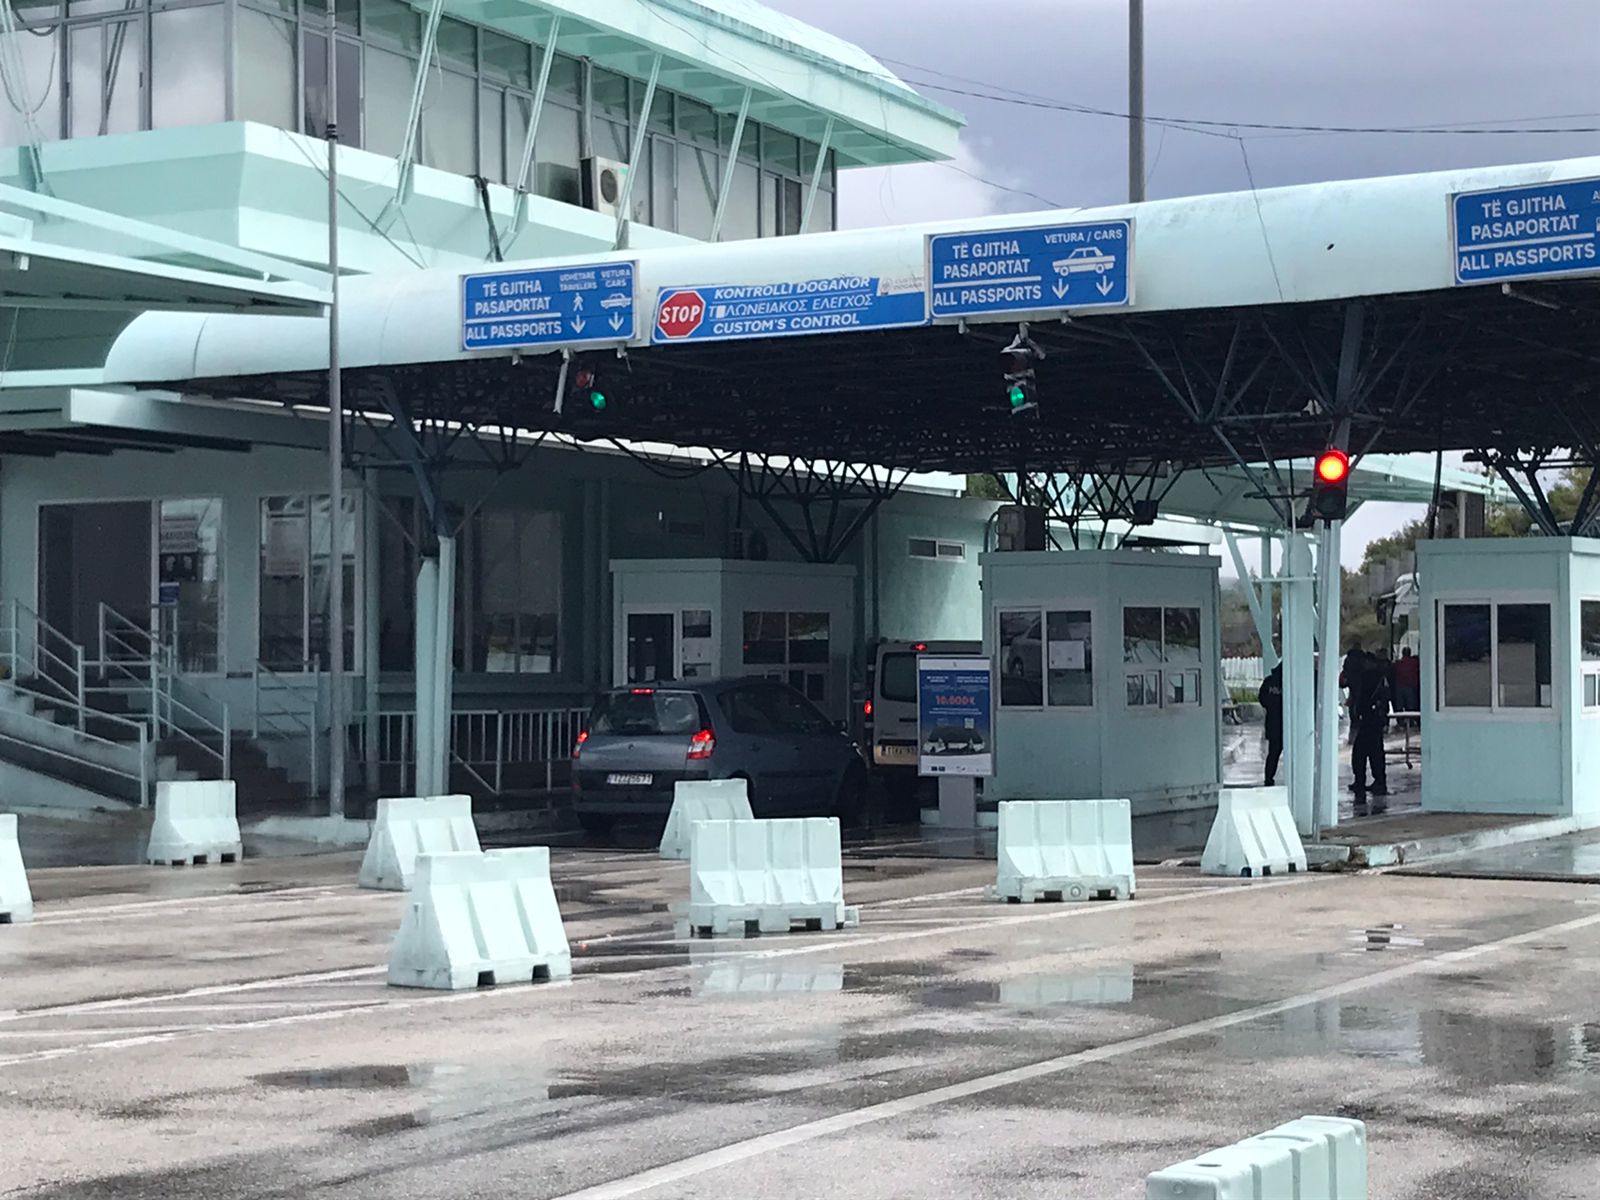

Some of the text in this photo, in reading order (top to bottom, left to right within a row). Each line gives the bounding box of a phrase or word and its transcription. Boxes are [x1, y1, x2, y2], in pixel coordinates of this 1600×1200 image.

[1481, 194, 1566, 218] TË GJITHA
[1044, 231, 1084, 245] VETURA
[1094, 229, 1123, 241] CARS
[1471, 214, 1580, 241] PASAPORTAT
[972, 240, 1020, 258] GJITHA
[1460, 243, 1596, 272] ALL PASSPORTS
[601, 269, 632, 280] VETURA
[943, 258, 1031, 279] PASAPORTAT
[500, 279, 543, 296] GJITHA
[605, 278, 628, 288] CARS
[714, 283, 793, 300] KONTROLLI
[796, 277, 871, 294] DOGANOR
[708, 293, 875, 319] ΤΛΩΝΕΙΑΚΟΣ ΕΛΕΓΧΟΣ
[933, 285, 1042, 307] ALL PASSPORTS
[474, 297, 552, 316] PASAPORTAT
[660, 304, 701, 324] STOP
[466, 321, 562, 341] ALL PASSPORTS
[713, 313, 860, 335] CUSTOM'S CONTROL
